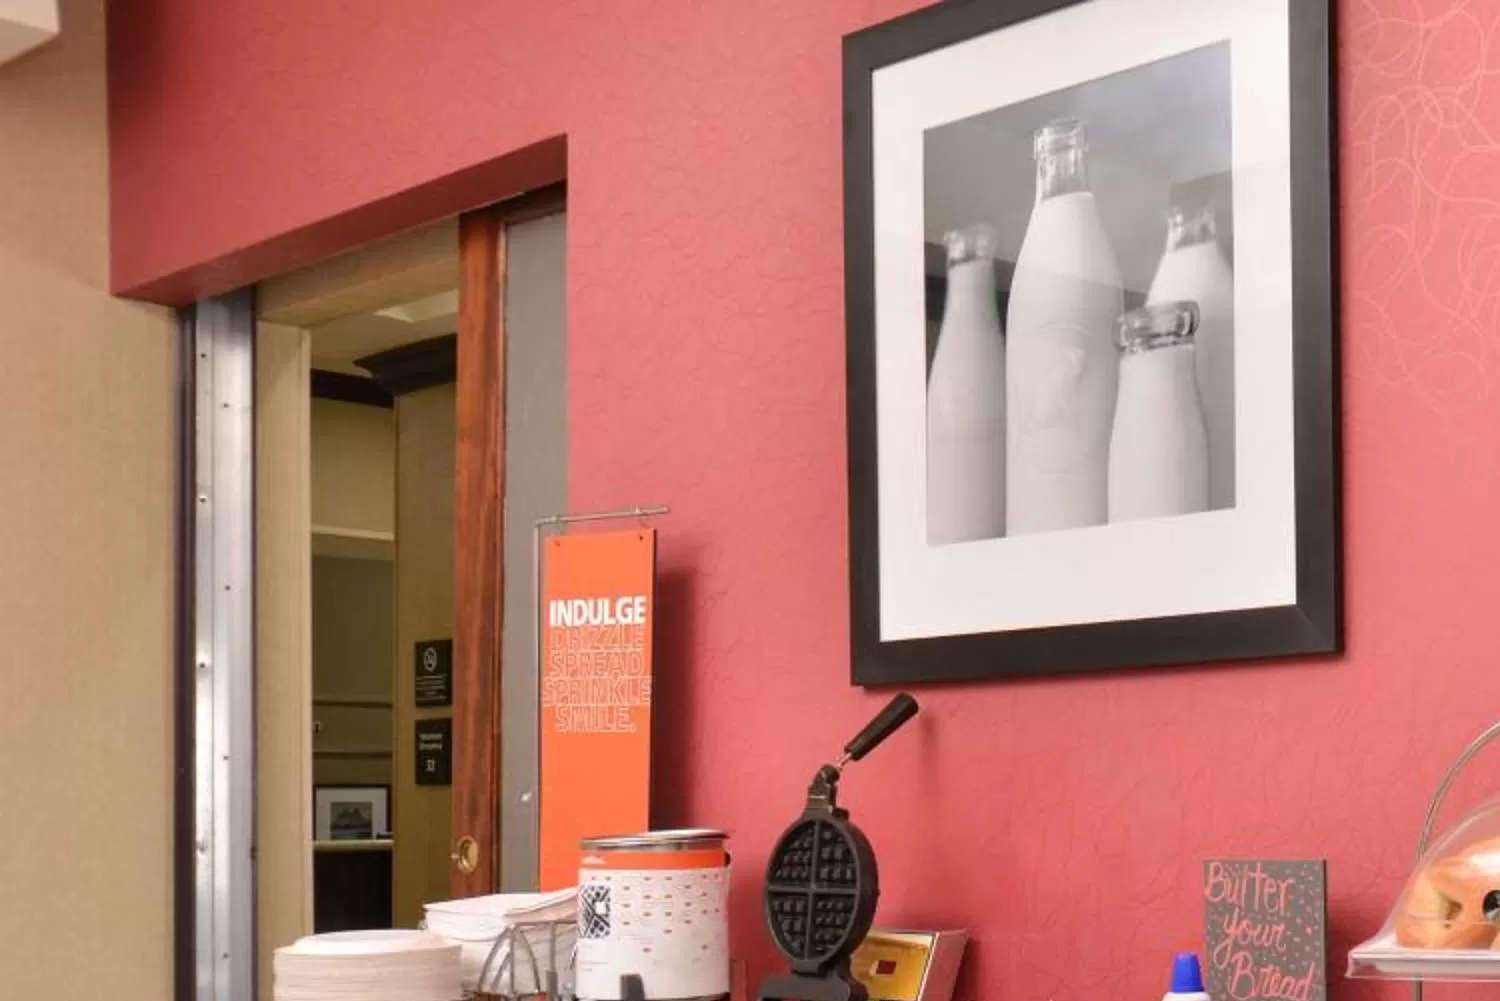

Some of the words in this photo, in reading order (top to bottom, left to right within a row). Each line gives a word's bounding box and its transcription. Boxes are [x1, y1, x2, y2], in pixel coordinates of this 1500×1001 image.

[549, 596, 647, 627] INDULGE
[550, 650, 645, 678] SPREAD
[543, 676, 652, 706] SPRINKLE
[1203, 861, 1296, 915] Butter
